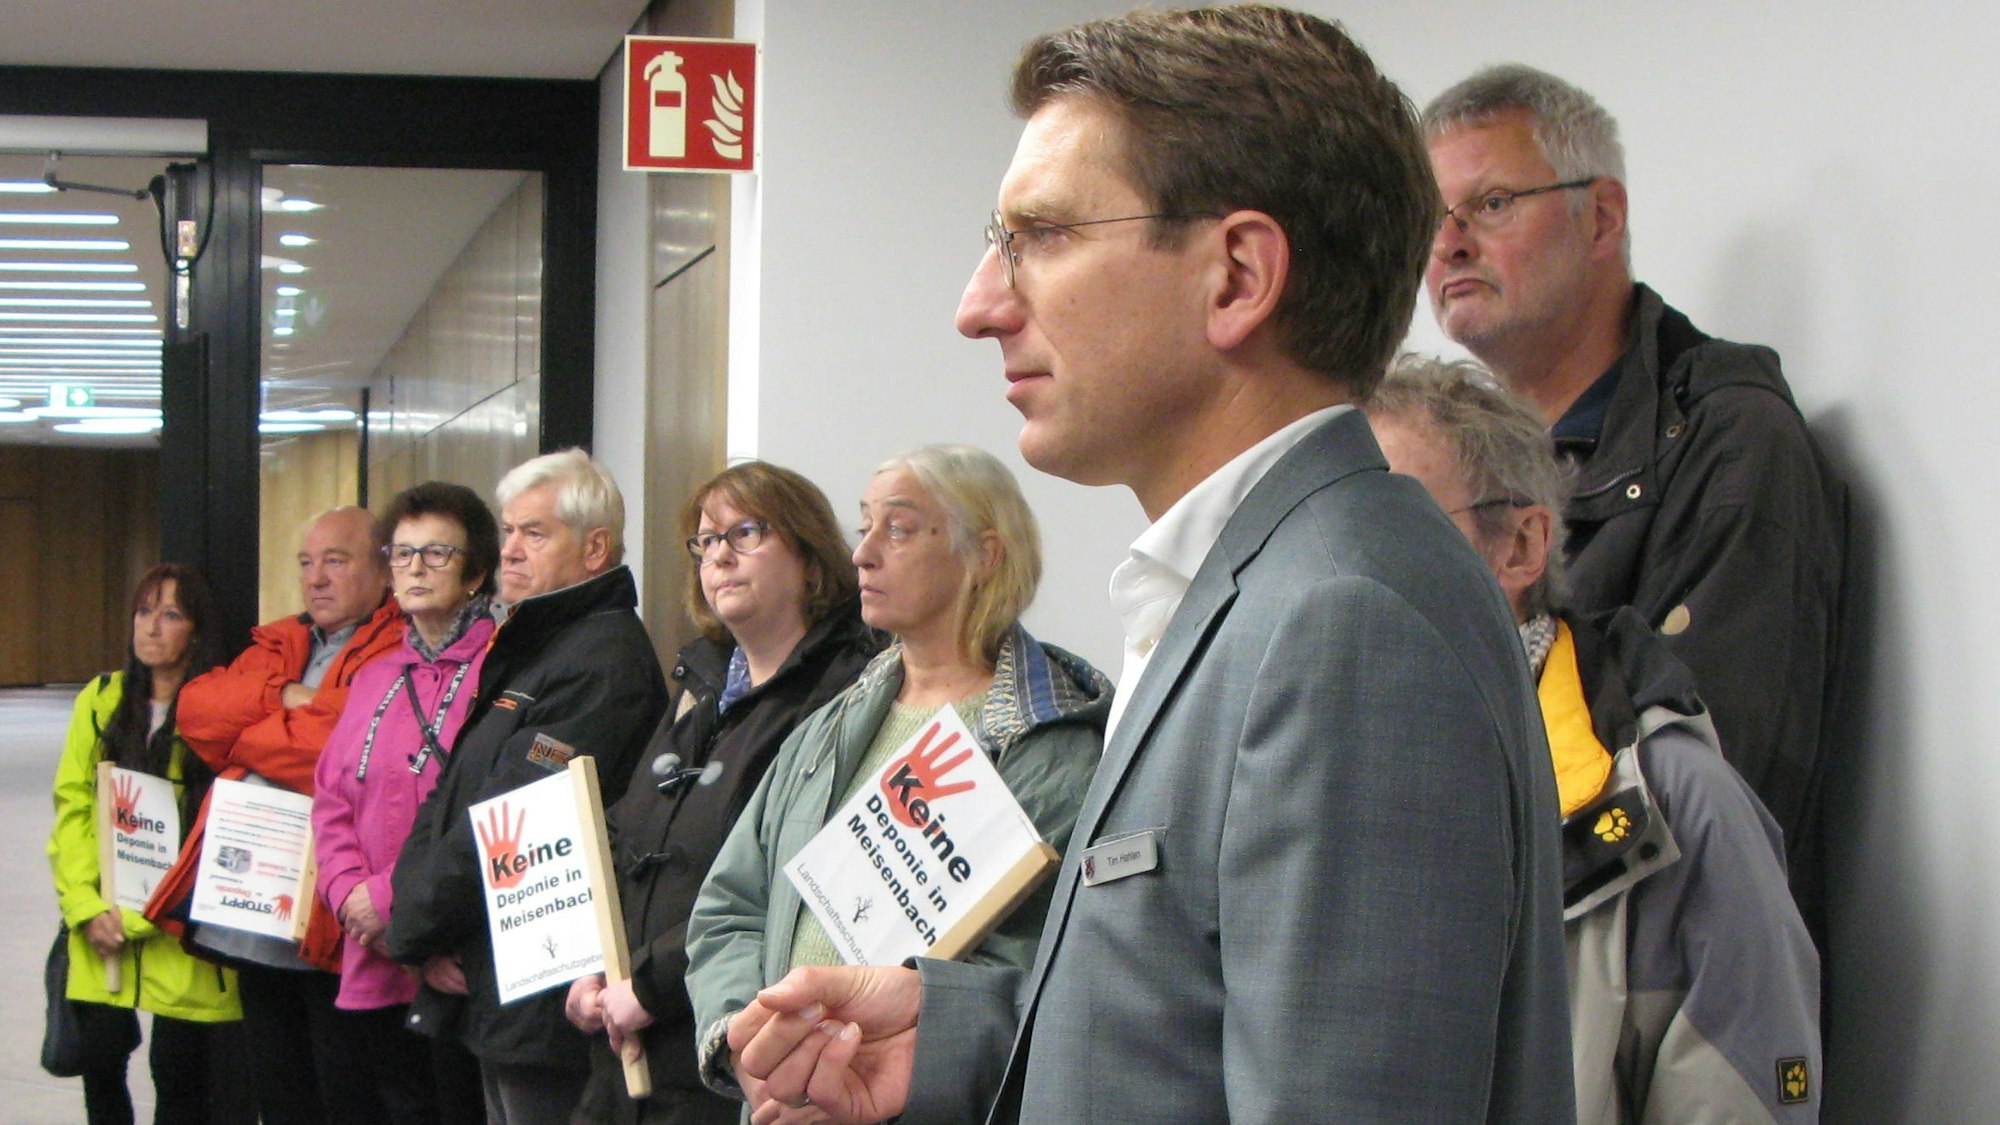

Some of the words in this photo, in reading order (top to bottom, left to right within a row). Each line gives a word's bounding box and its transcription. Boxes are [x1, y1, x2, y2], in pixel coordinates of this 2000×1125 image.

[116, 806, 165, 833] Keine
[888, 763, 971, 883] Keine
[116, 832, 155, 851] Deponie
[157, 842, 167, 853] in
[492, 837, 573, 882] Keine
[865, 793, 928, 885] Deponie
[928, 886, 948, 912] in
[496, 875, 560, 909] Deponie
[565, 868, 582, 883] in
[847, 814, 937, 947] Meisenbach
[219, 895, 273, 914] STOPPT
